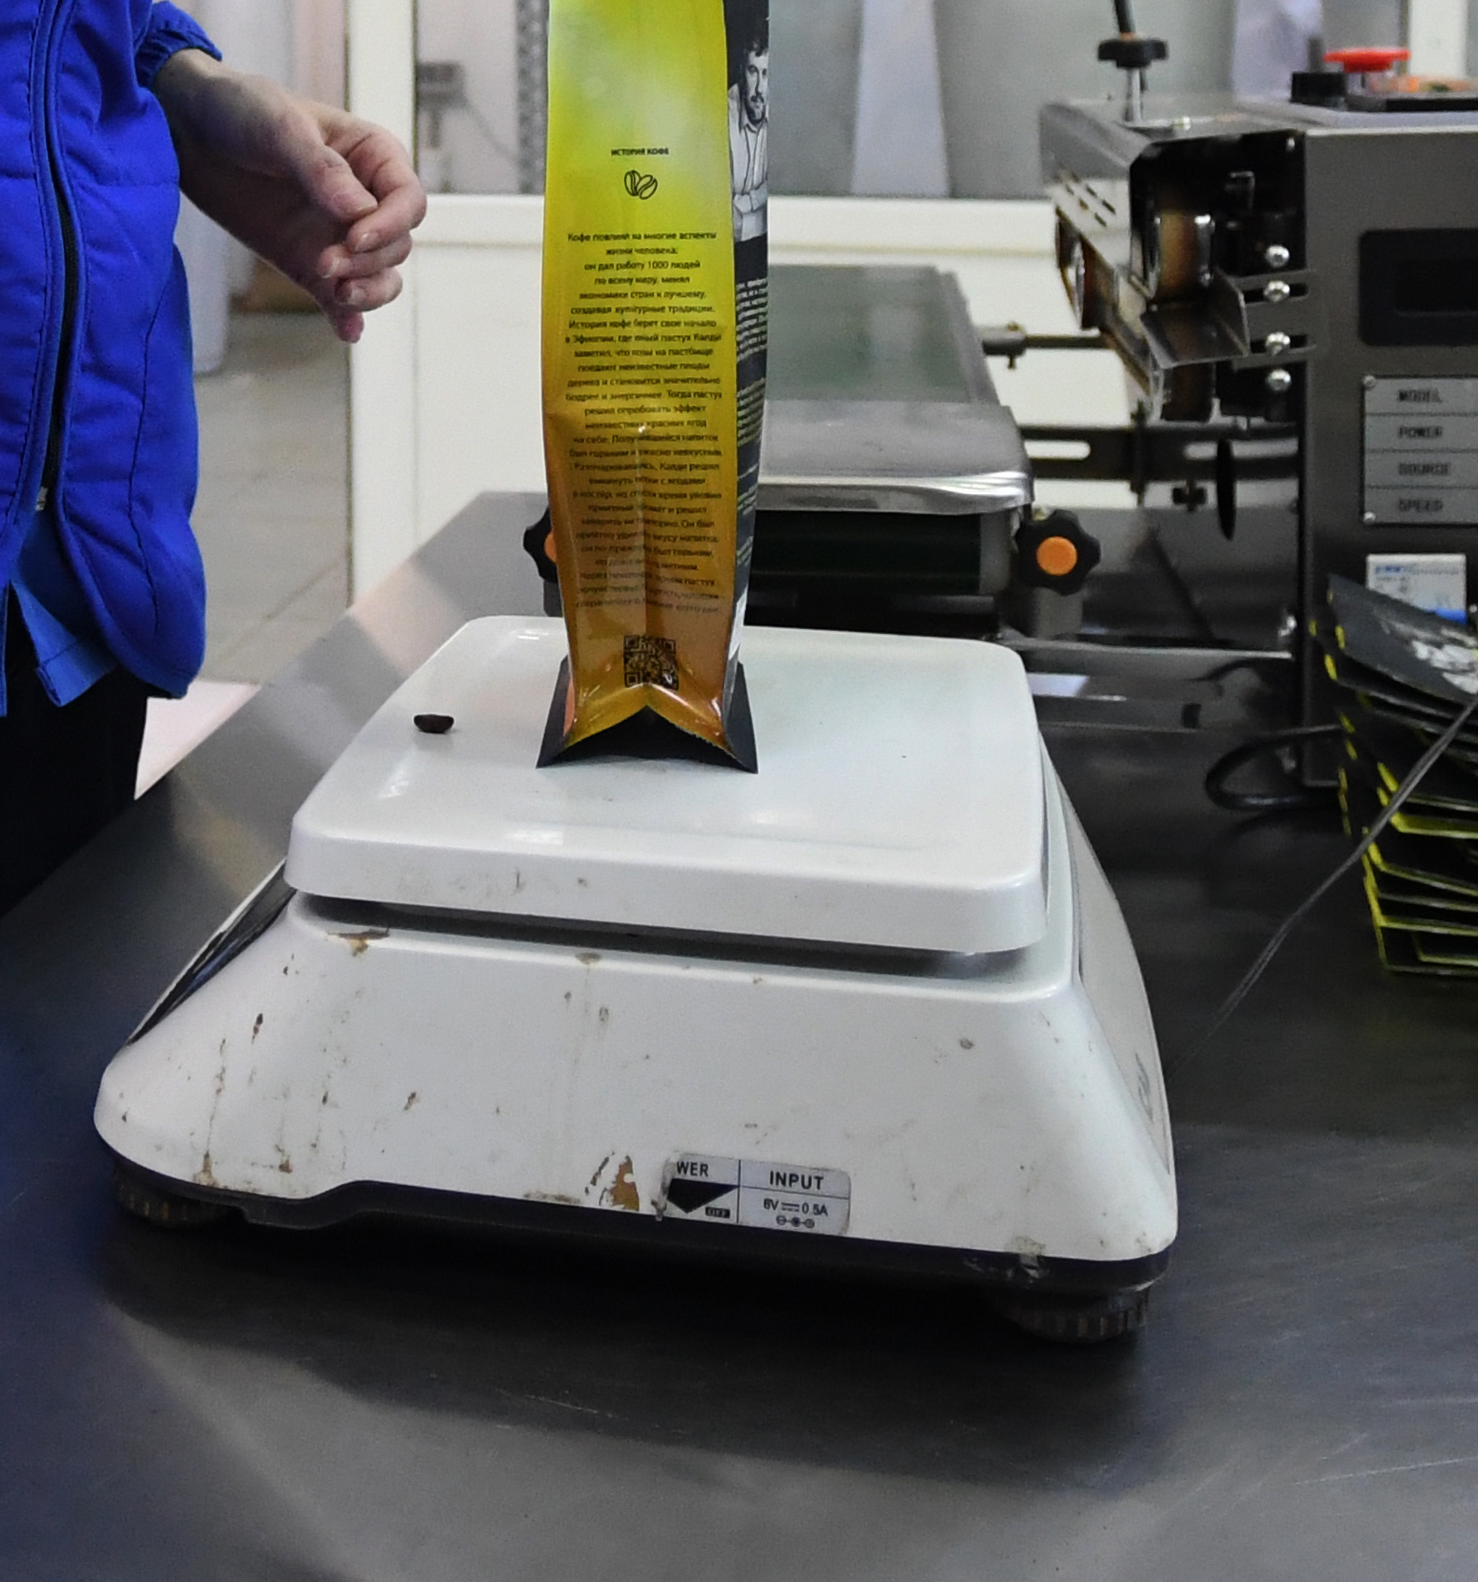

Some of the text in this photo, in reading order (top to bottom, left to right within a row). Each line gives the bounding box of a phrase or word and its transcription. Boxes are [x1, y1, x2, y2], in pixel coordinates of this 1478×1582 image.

[647, 147, 669, 156] КОФЕ
[567, 233, 591, 243] Кофе
[584, 259, 701, 272] он дал работу 1000 людей
[594, 277, 606, 285] по
[608, 276, 634, 286] всему
[630, 291, 655, 300] стран
[568, 319, 607, 330] История
[609, 318, 632, 329] кофе
[683, 319, 717, 328] начало
[618, 334, 633, 343] где
[660, 334, 691, 343] пастух
[666, 389, 692, 399] Тогда
[673, 403, 706, 414] эффект
[770, 1170, 823, 1190] INPUT
